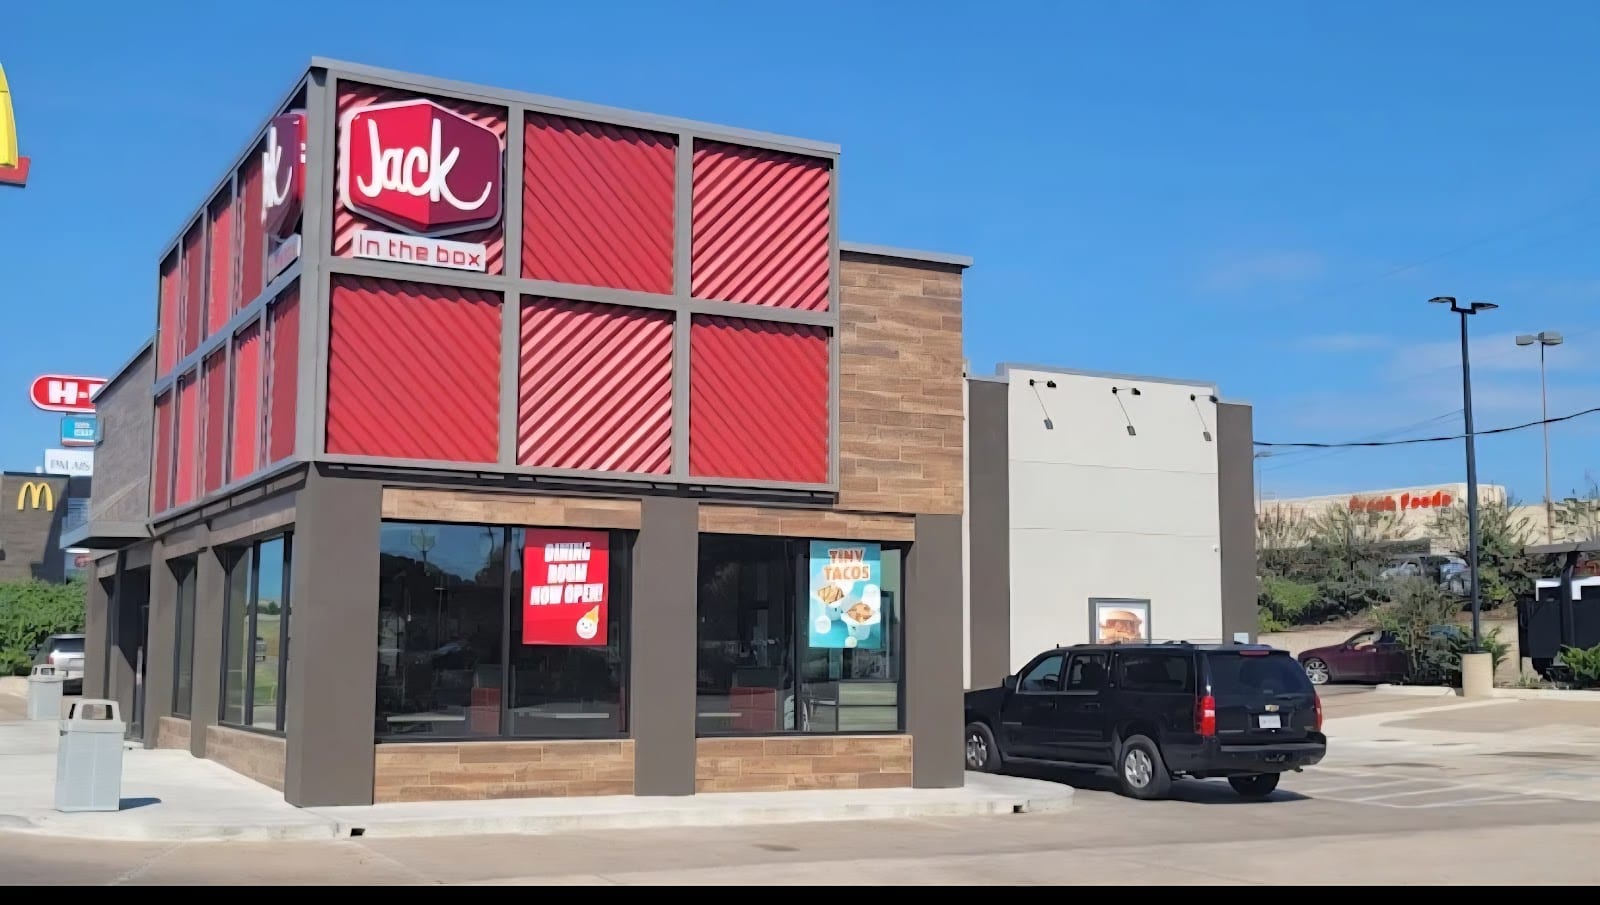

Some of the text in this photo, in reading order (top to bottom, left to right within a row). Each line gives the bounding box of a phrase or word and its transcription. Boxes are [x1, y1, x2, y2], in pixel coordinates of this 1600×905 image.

[356, 118, 492, 211] Jack
[389, 239, 429, 261] the
[437, 245, 481, 267] box
[829, 550, 863, 564] TINY
[823, 566, 869, 580] TACOS
